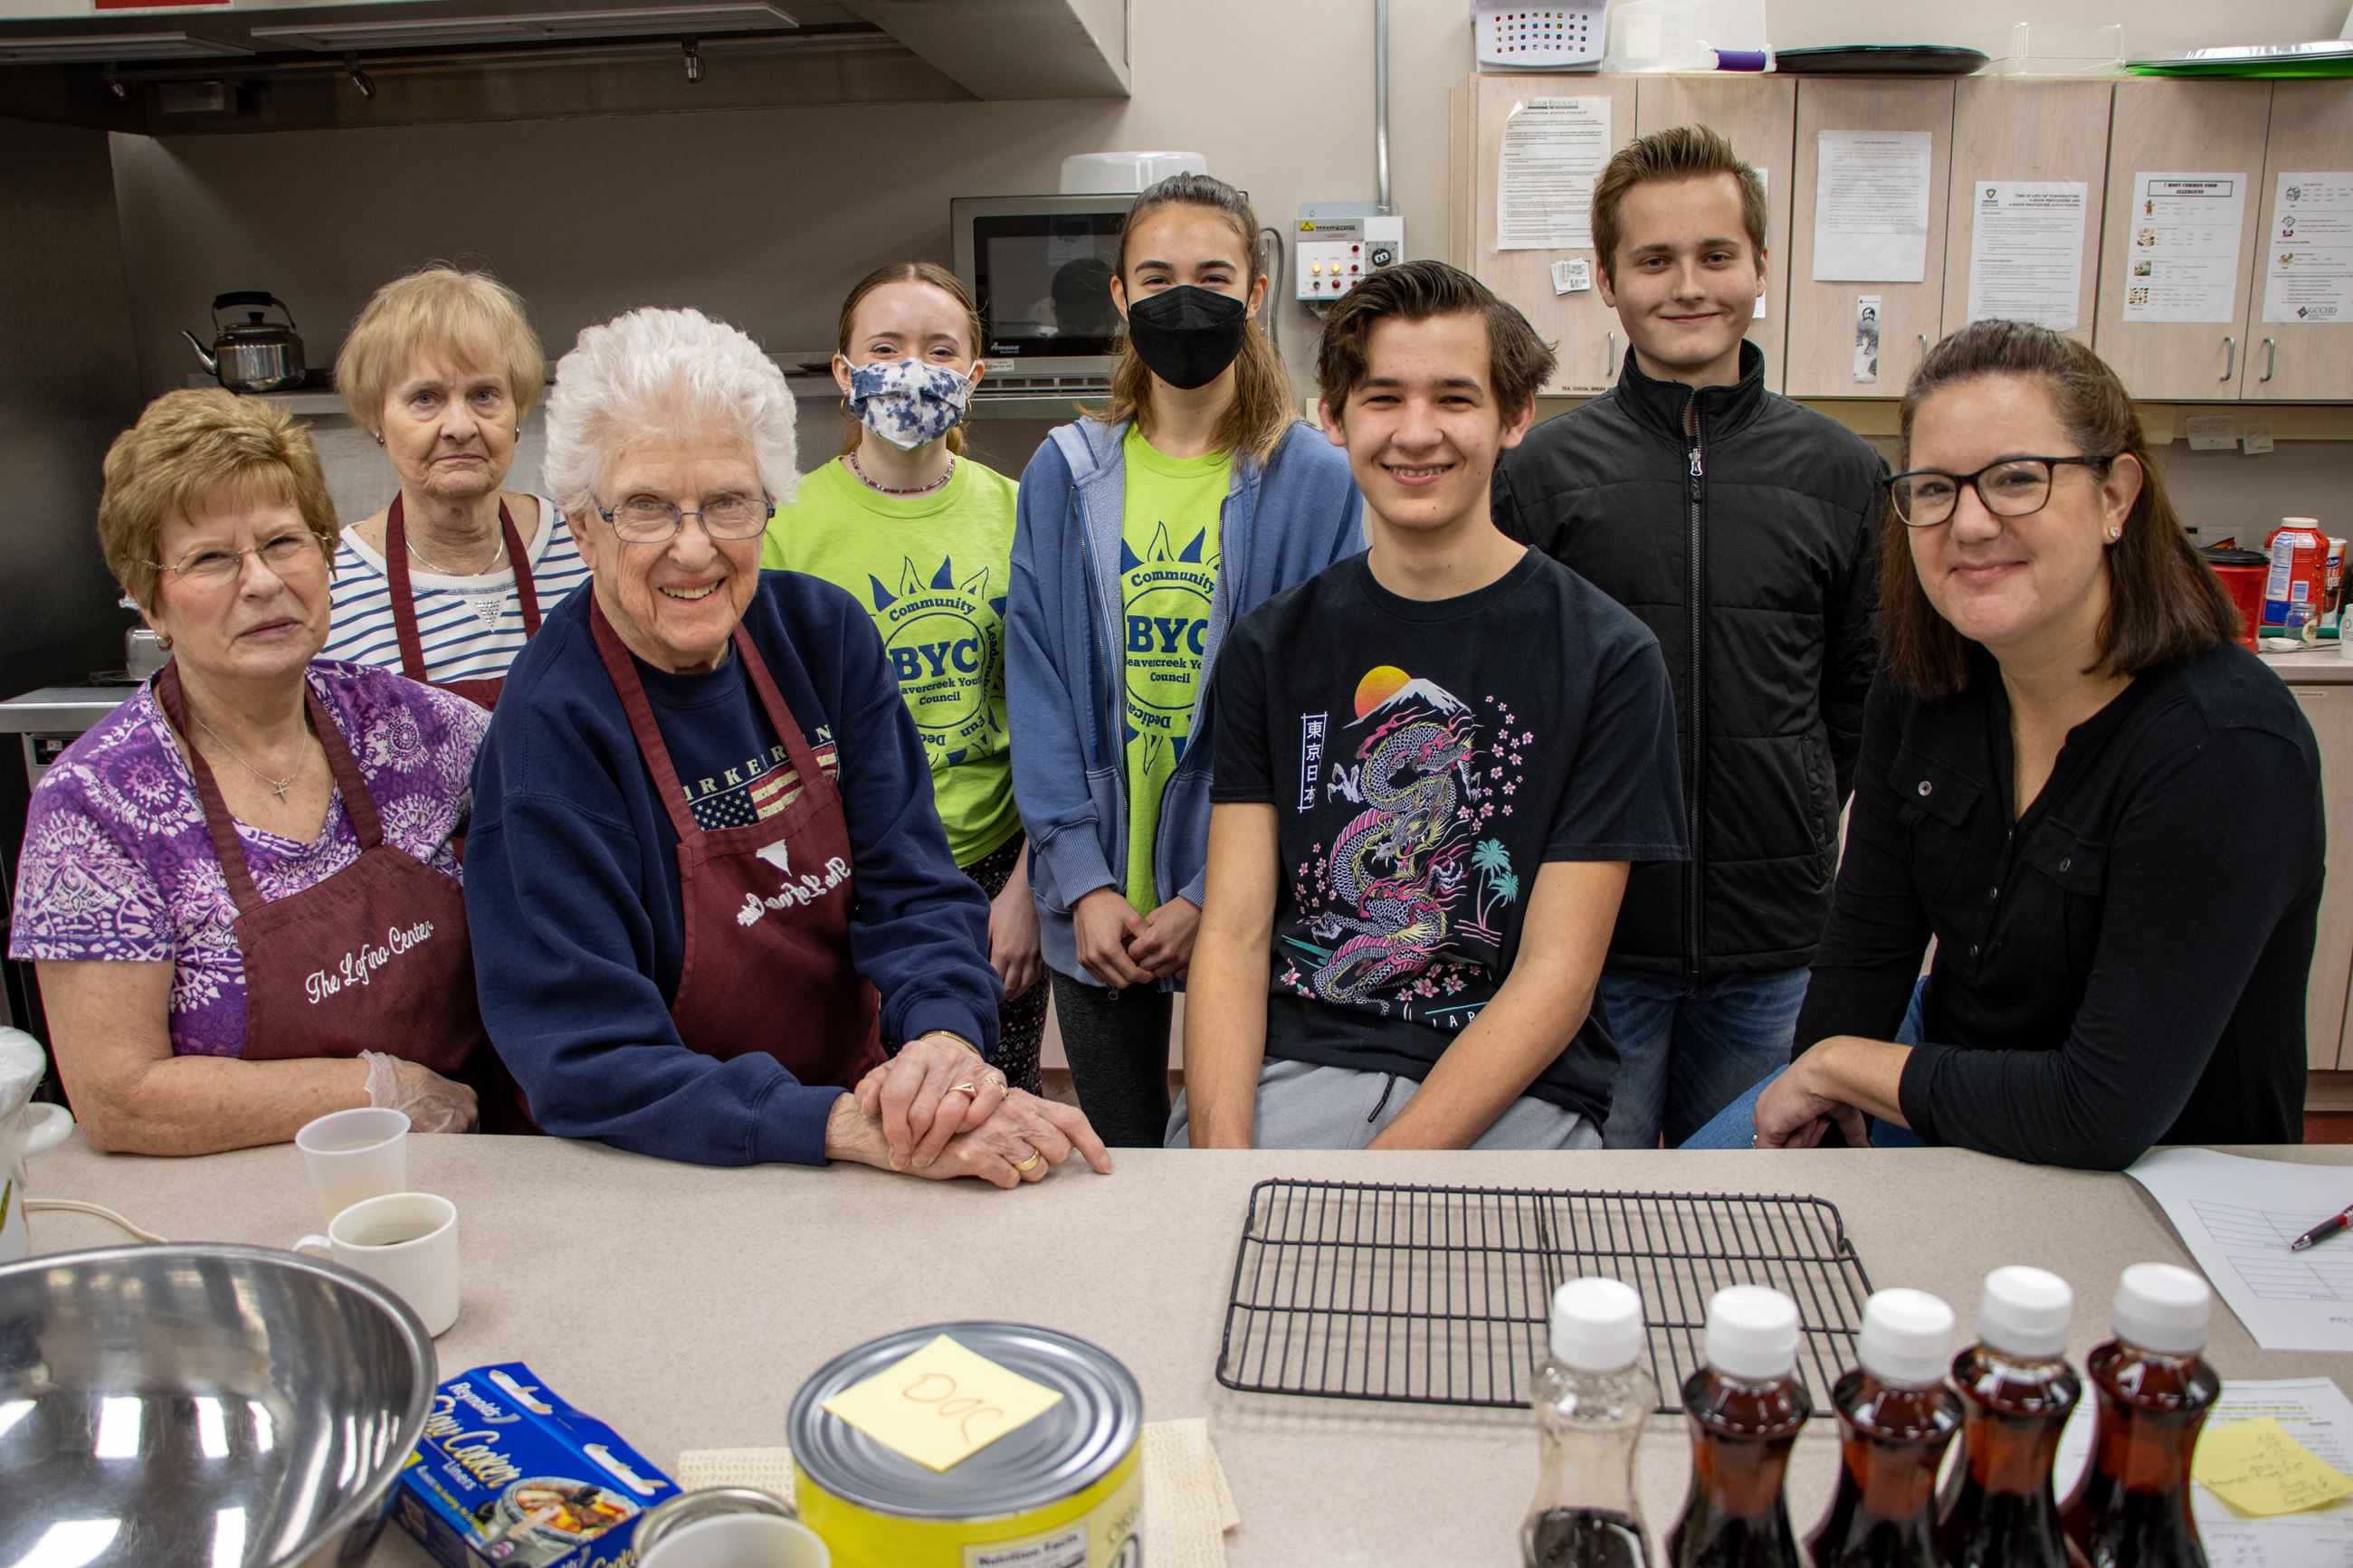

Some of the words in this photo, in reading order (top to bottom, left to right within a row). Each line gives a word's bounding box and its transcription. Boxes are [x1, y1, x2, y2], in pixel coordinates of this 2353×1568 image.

[990, 341, 1020, 351] Amana
[1130, 570, 1215, 594] Community
[889, 597, 976, 622] Community
[1127, 615, 1209, 656] BYC
[889, 637, 979, 681] BYC
[1126, 658, 1186, 669] eavercreek
[901, 678, 956, 695] avercreek
[1150, 671, 1191, 683] Council
[919, 690, 961, 705] Council
[960, 714, 986, 737] Fun
[1127, 701, 1172, 729] Dedica
[1304, 720, 1323, 803] 東京日本
[305, 969, 341, 1004] The
[388, 920, 434, 955] Center
[447, 1382, 501, 1418] Reynolds
[443, 1430, 523, 1489] Cooker
[442, 1459, 477, 1492] Liners
[978, 1547, 1041, 1565] Nutrition
[1043, 1533, 1079, 1552] Facts
